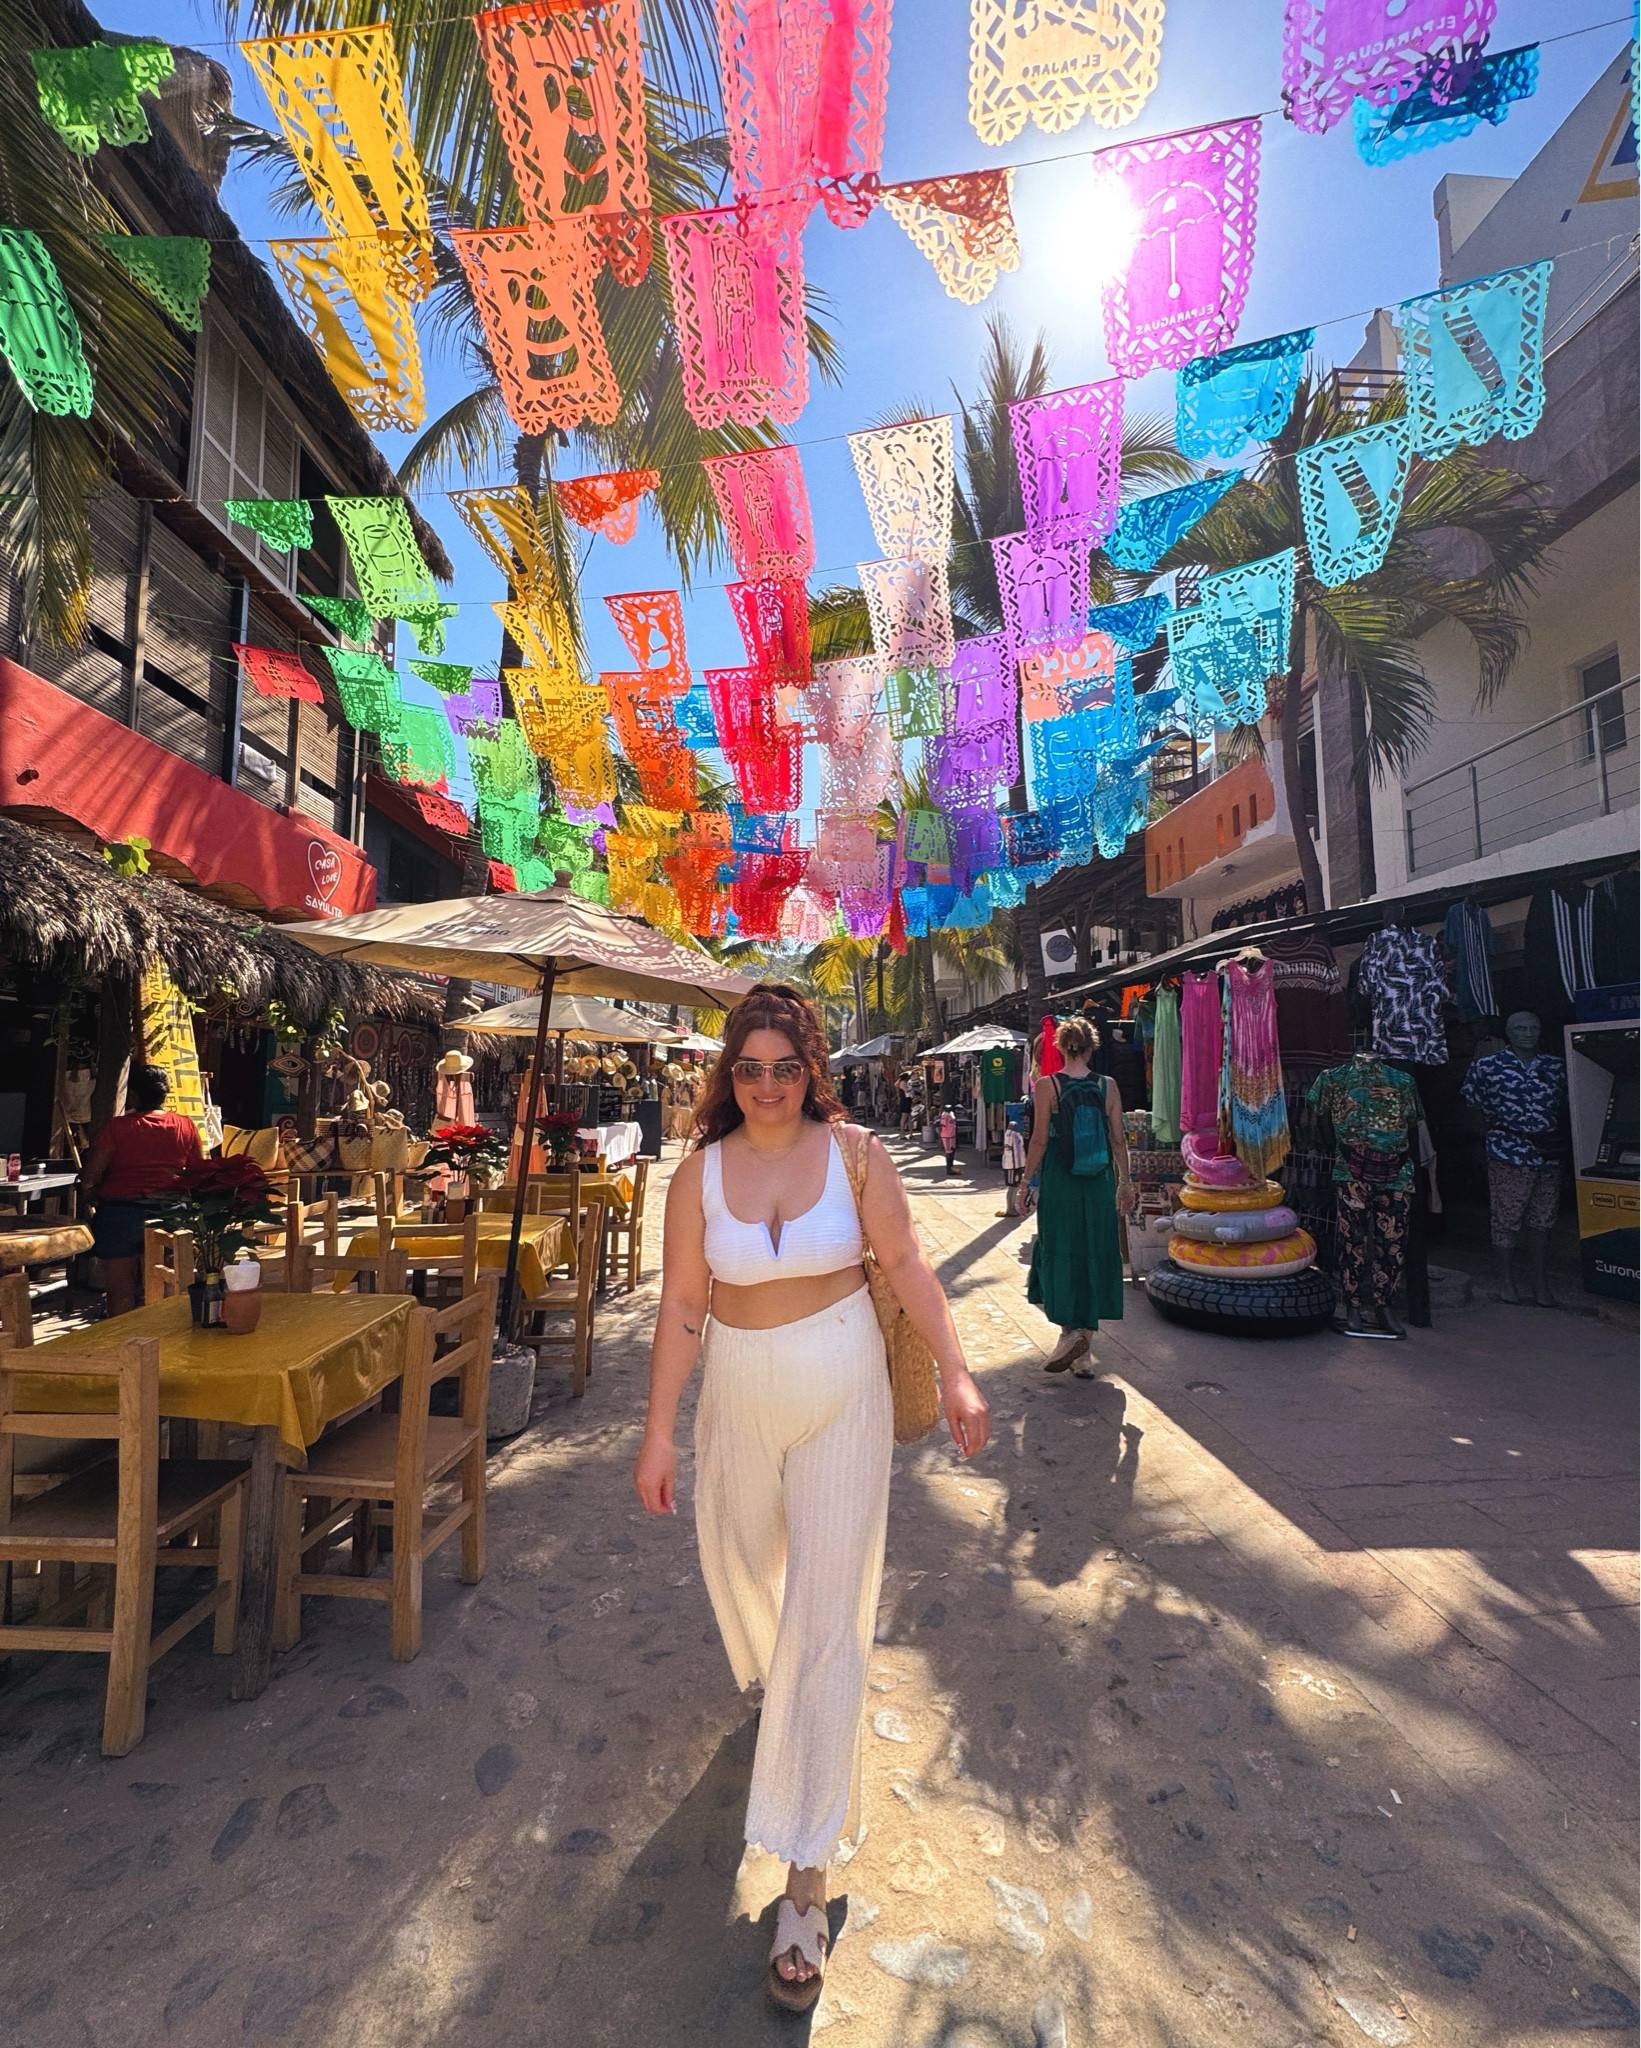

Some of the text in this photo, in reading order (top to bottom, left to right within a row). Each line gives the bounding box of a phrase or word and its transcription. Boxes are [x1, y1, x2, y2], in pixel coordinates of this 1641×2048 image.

[314, 857, 336, 871] CASA
[321, 872, 338, 885] LOVE
[305, 894, 343, 917] SAYULITA
